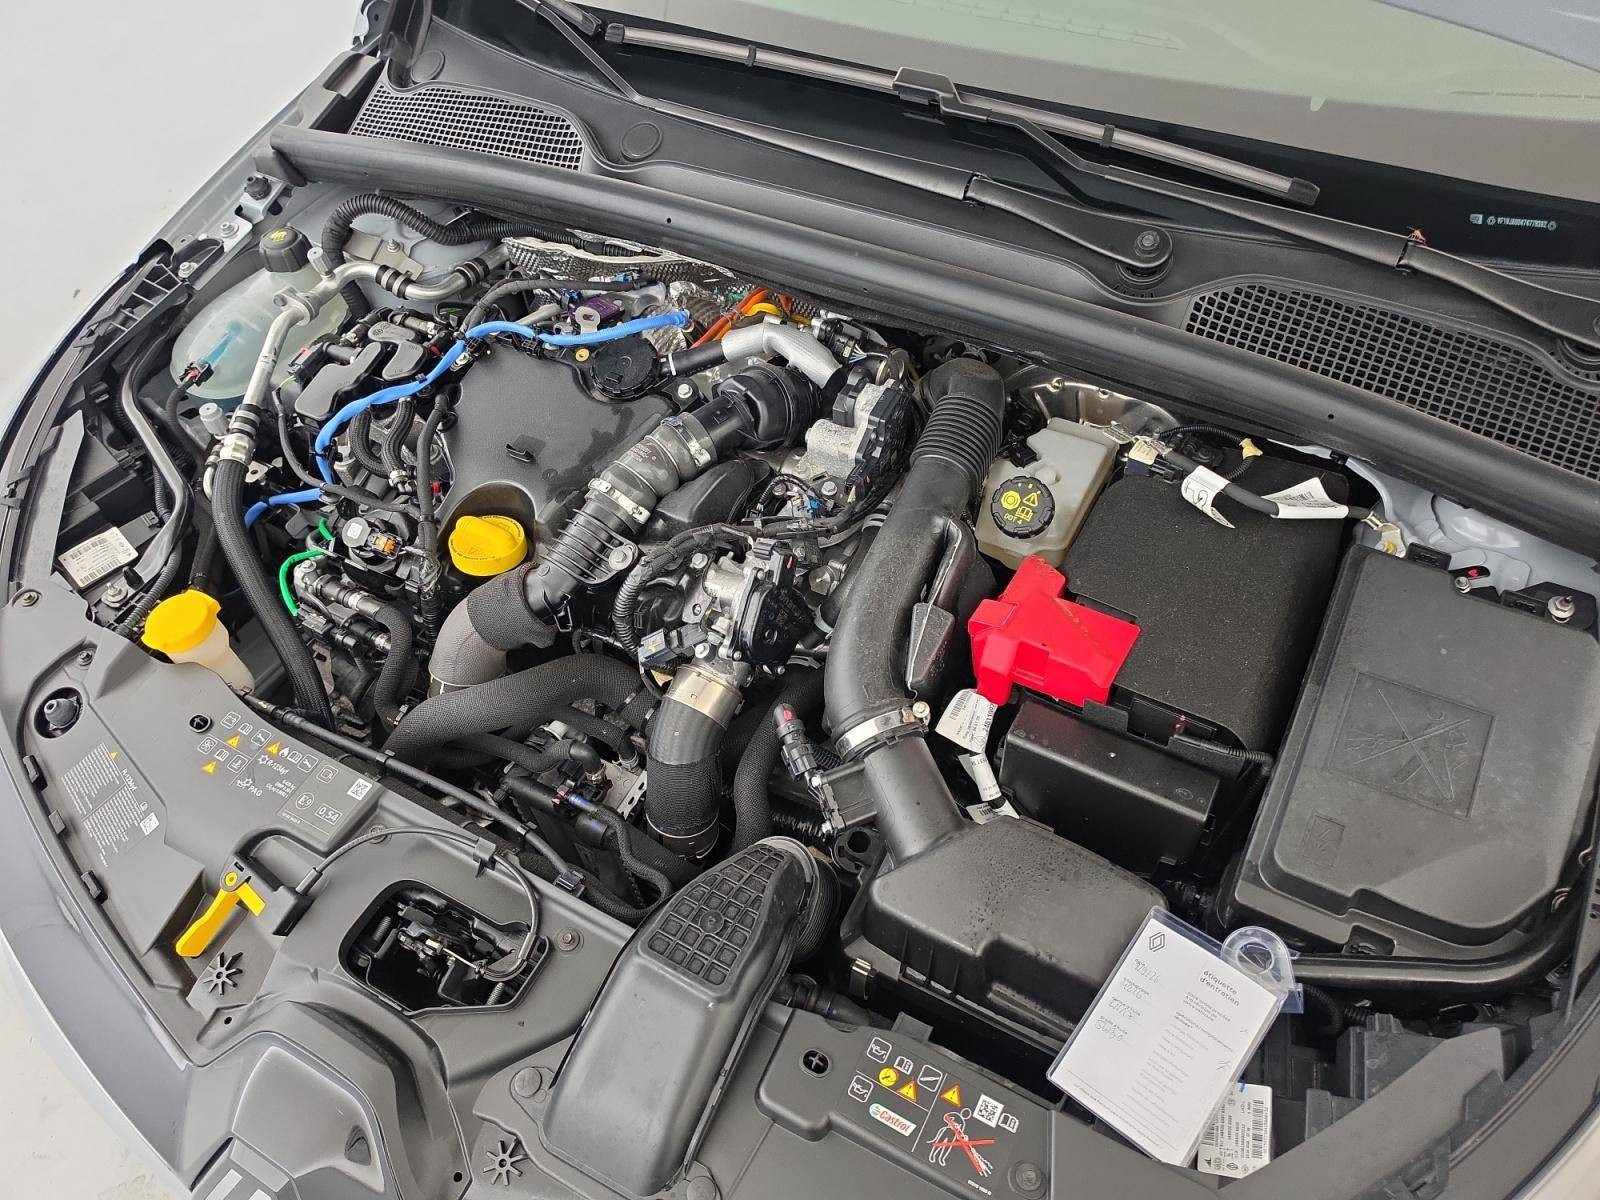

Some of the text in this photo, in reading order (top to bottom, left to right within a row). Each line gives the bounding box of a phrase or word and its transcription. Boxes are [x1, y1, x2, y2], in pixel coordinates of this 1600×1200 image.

[1004, 513, 1017, 522] DOT
[248, 785, 263, 797] PAG
[319, 806, 339, 822] 0,54
[880, 1110, 911, 1132] Castrol
